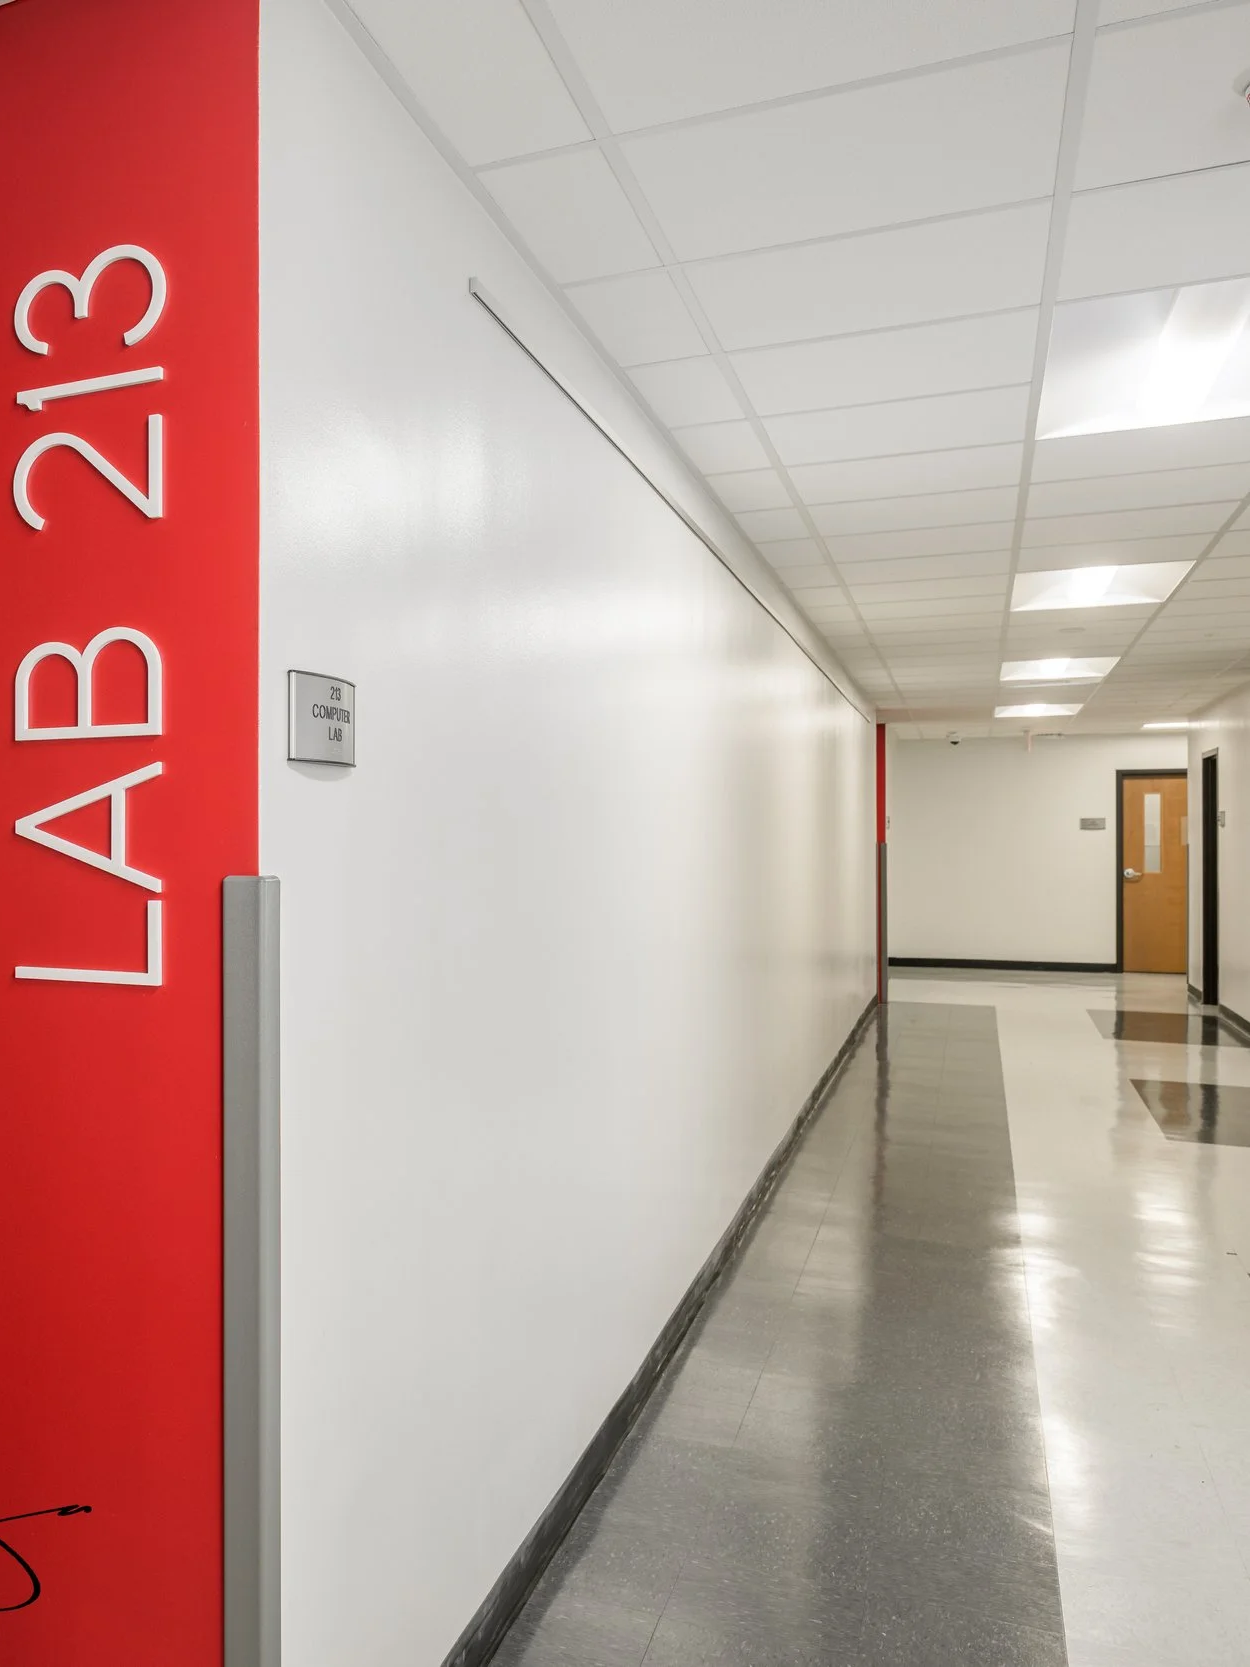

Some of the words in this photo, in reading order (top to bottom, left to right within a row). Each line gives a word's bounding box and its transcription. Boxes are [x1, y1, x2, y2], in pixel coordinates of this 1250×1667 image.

[13, 244, 167, 531] 213
[330, 686, 342, 701] 213
[312, 704, 350, 724] COMPUTER
[328, 726, 343, 742] LAB
[14, 627, 163, 987] LAB
